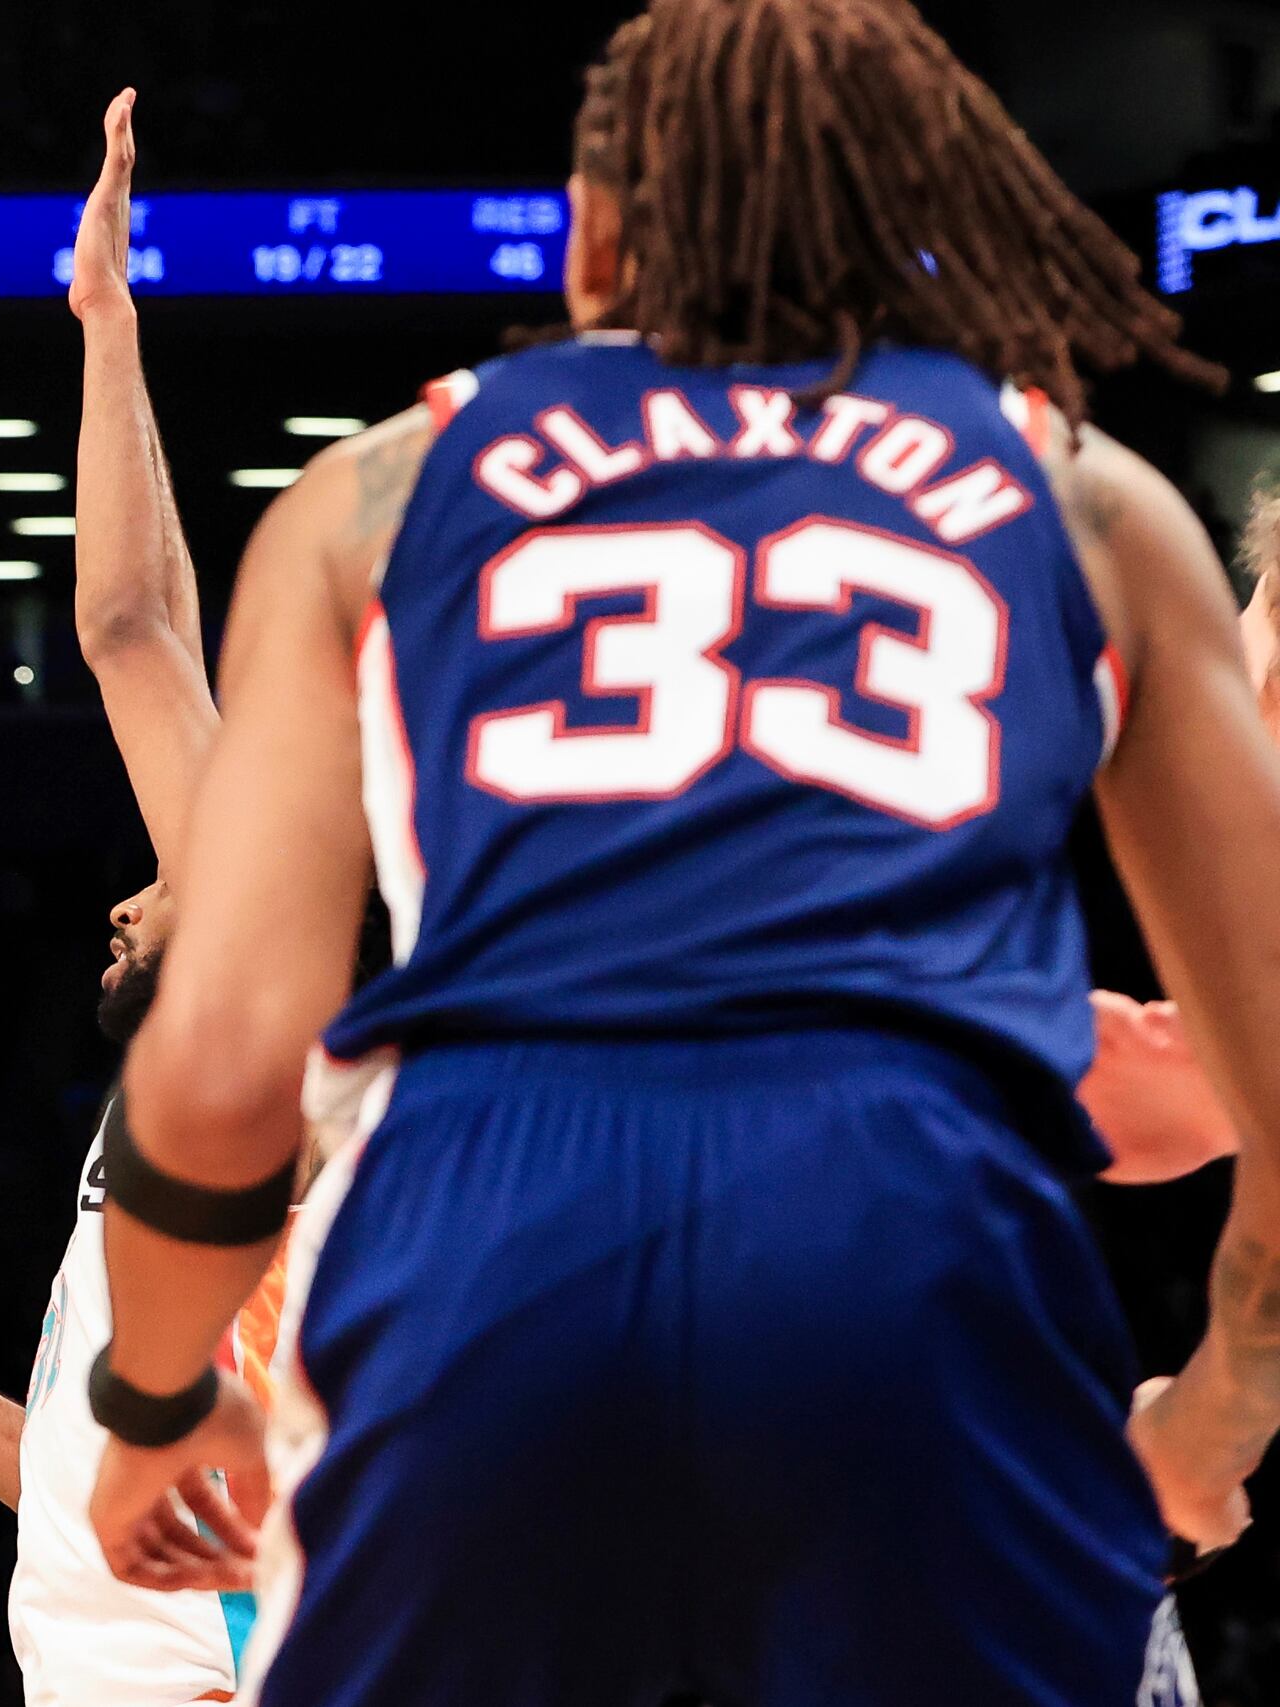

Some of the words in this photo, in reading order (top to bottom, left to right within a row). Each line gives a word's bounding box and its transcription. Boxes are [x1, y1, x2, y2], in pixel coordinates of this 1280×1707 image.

[287, 197, 341, 235] FT
[474, 385, 1033, 545] CLAXTON
[465, 516, 1009, 830] 33
